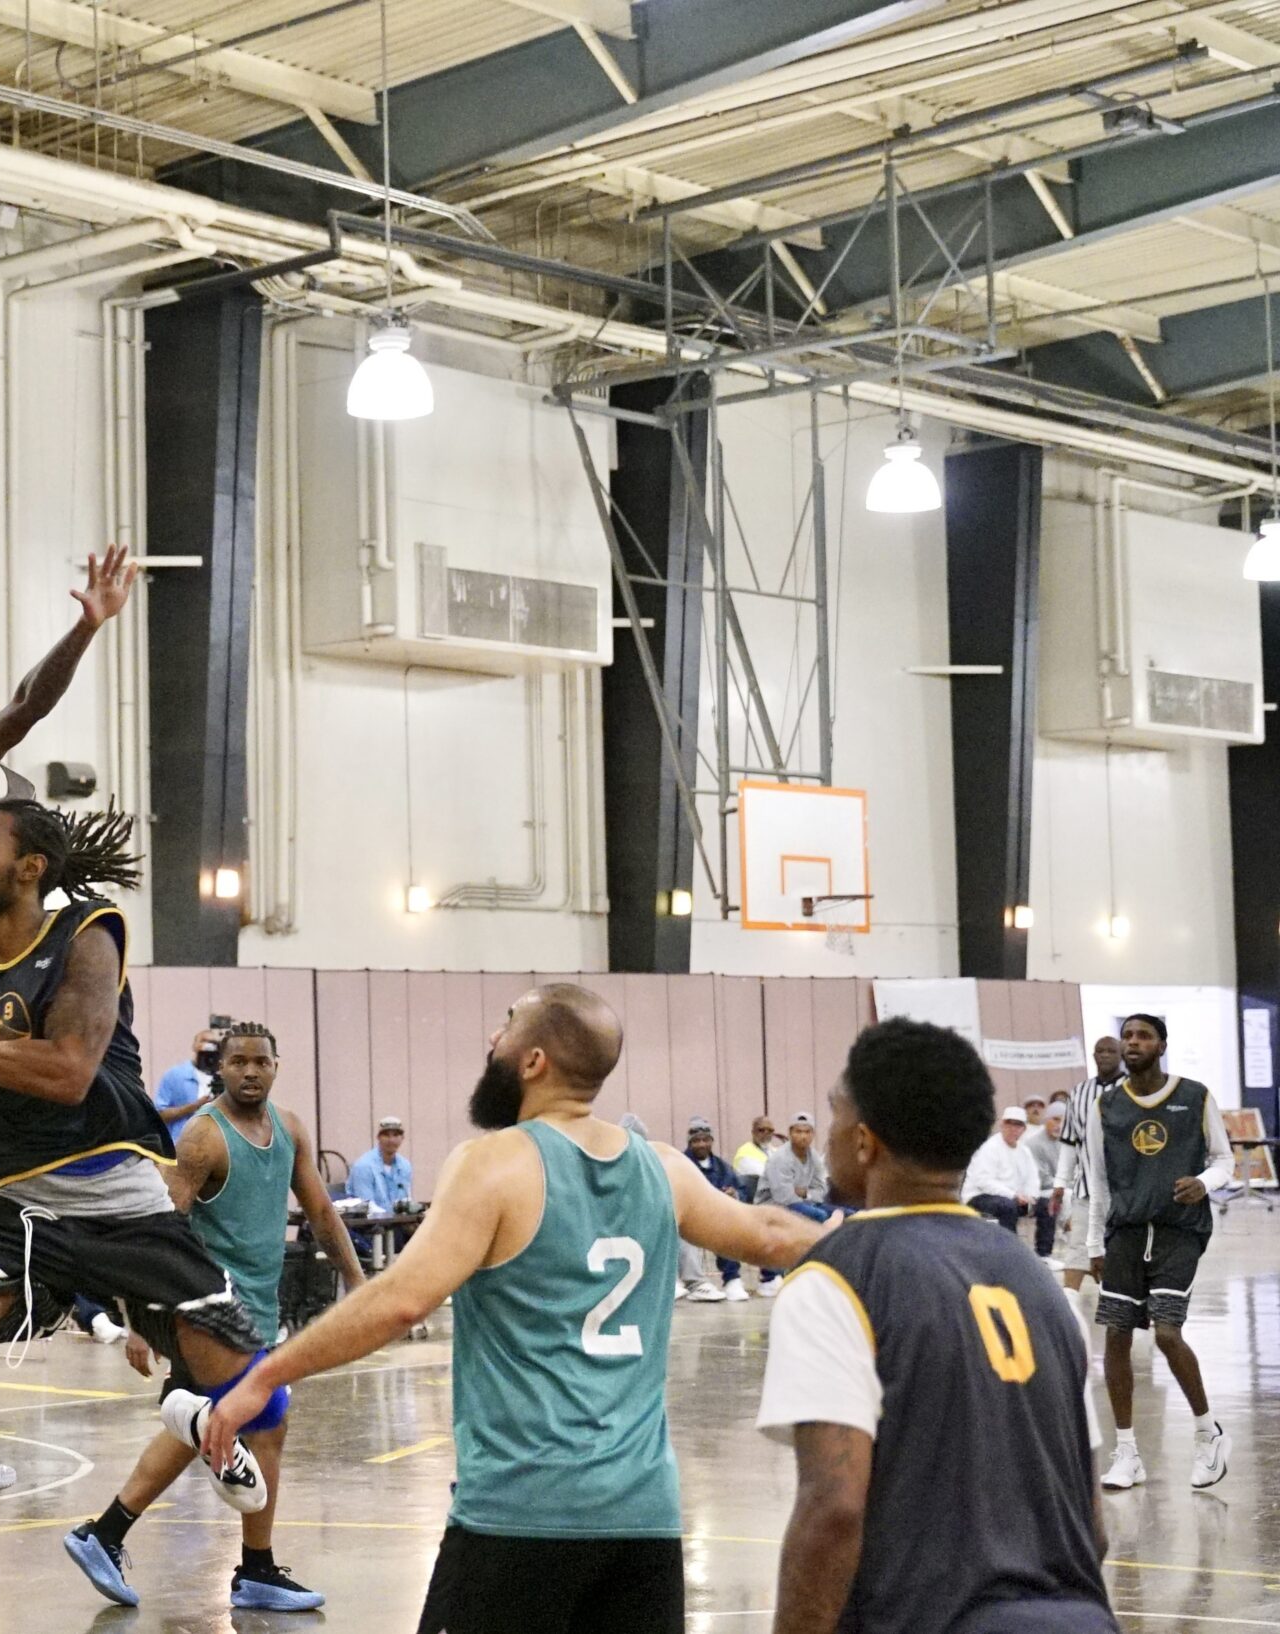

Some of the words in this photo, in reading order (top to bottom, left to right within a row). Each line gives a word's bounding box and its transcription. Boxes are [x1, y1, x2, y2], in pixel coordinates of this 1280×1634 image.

[4, 1001, 14, 1020] 9
[1148, 1124, 1157, 1135] 2
[581, 1236, 645, 1355] 2
[968, 1284, 1036, 1384] 0
